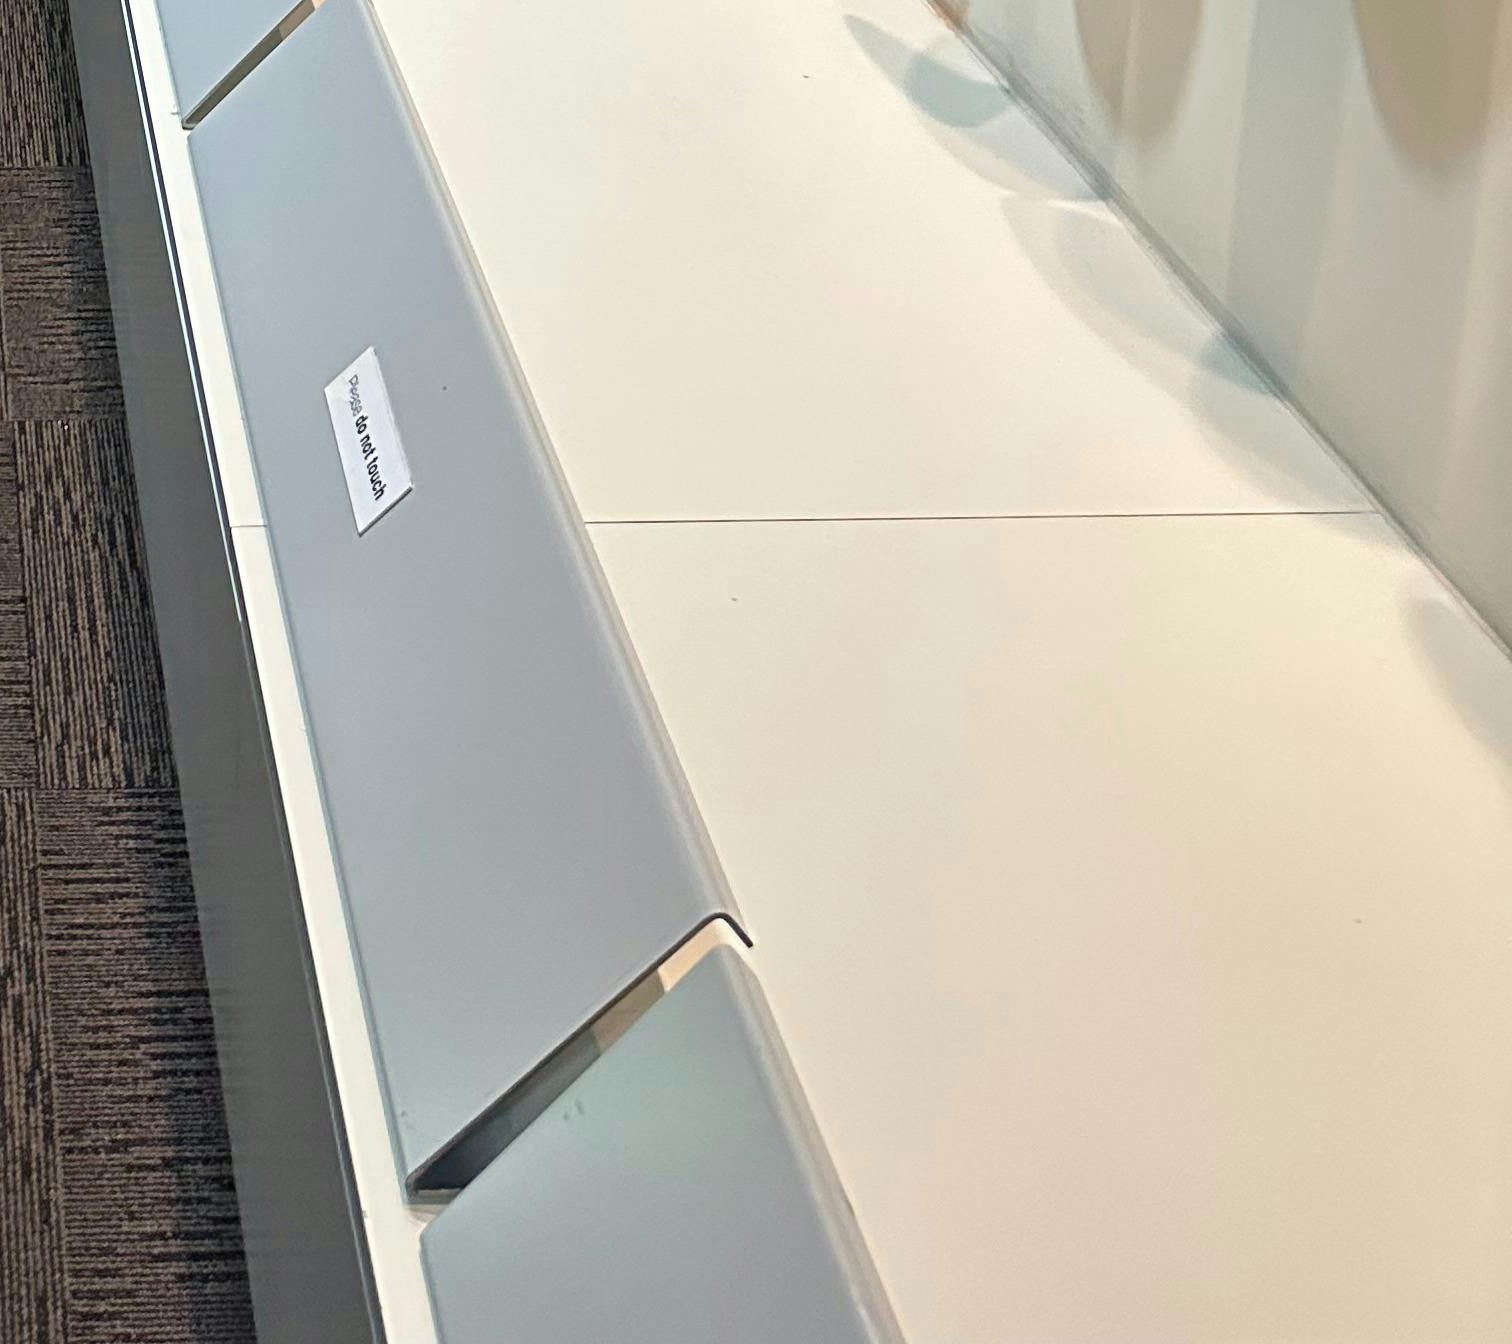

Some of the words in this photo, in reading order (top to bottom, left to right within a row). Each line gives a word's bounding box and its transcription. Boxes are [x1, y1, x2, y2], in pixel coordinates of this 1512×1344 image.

[355, 414, 369, 435] do
[359, 432, 377, 461] not
[366, 455, 387, 502] touch
